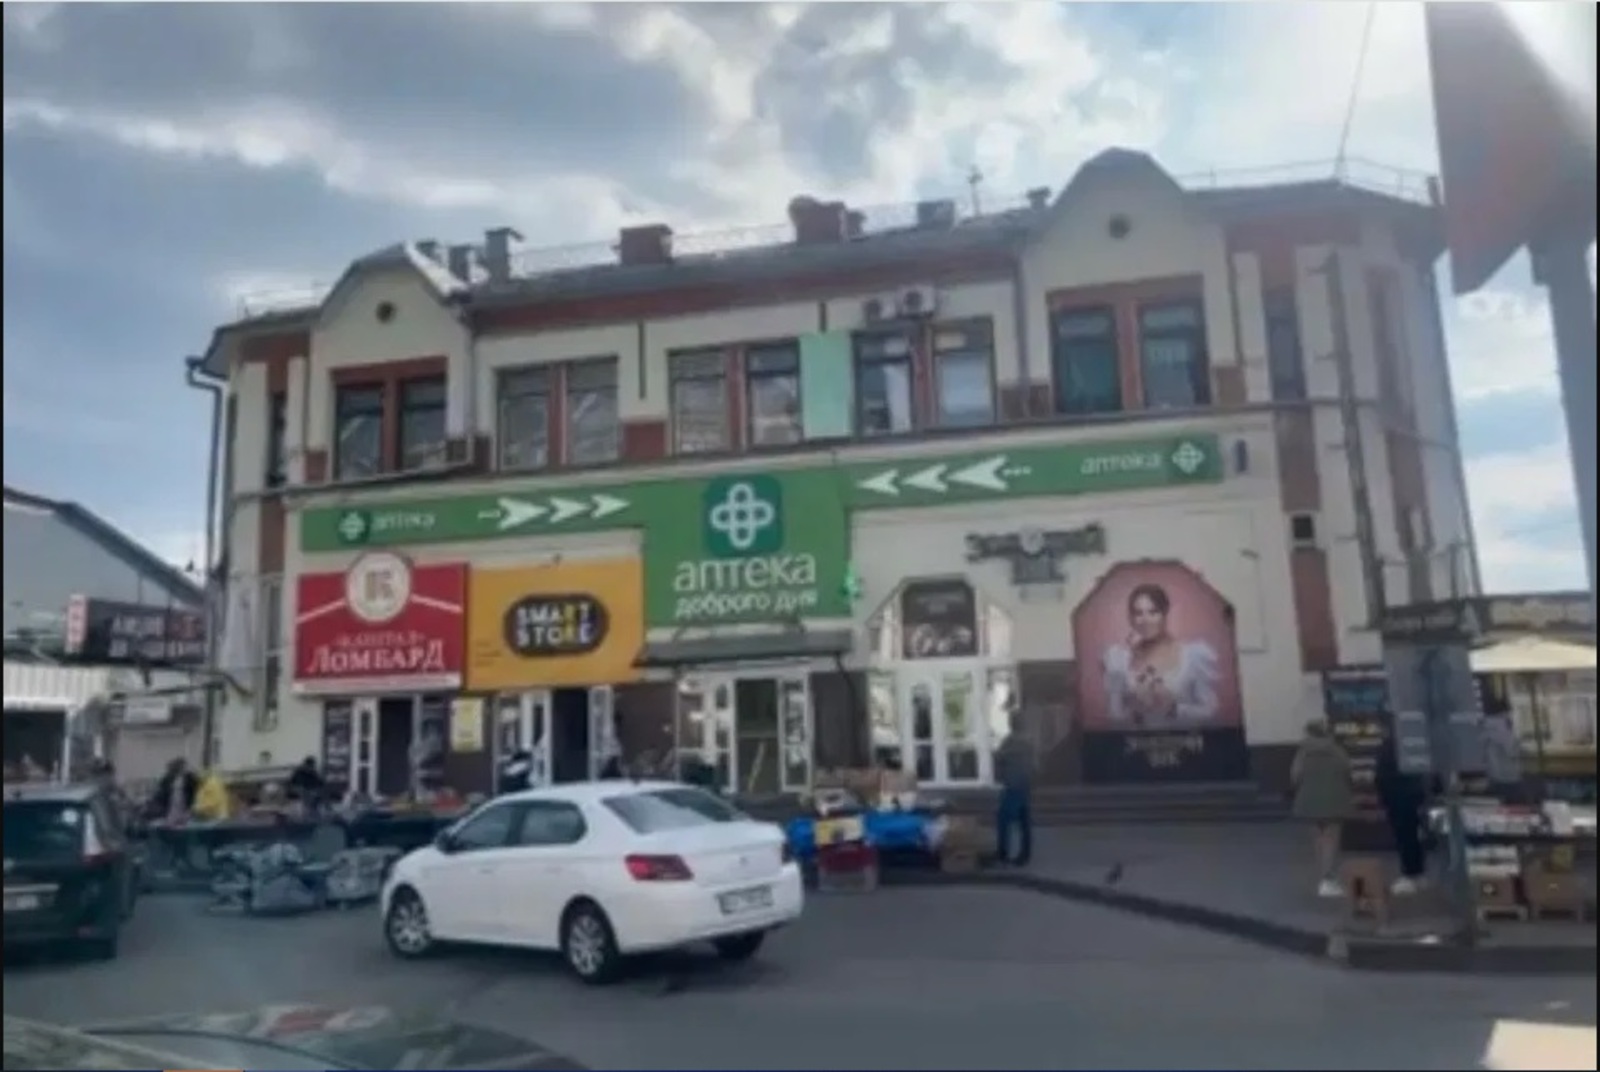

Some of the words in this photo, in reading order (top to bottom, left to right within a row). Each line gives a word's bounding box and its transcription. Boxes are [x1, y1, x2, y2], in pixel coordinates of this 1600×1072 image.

[674, 554, 816, 591] аптека
[516, 602, 590, 625] SMART
[675, 592, 771, 618] доброго
[516, 623, 591, 647] STORE
